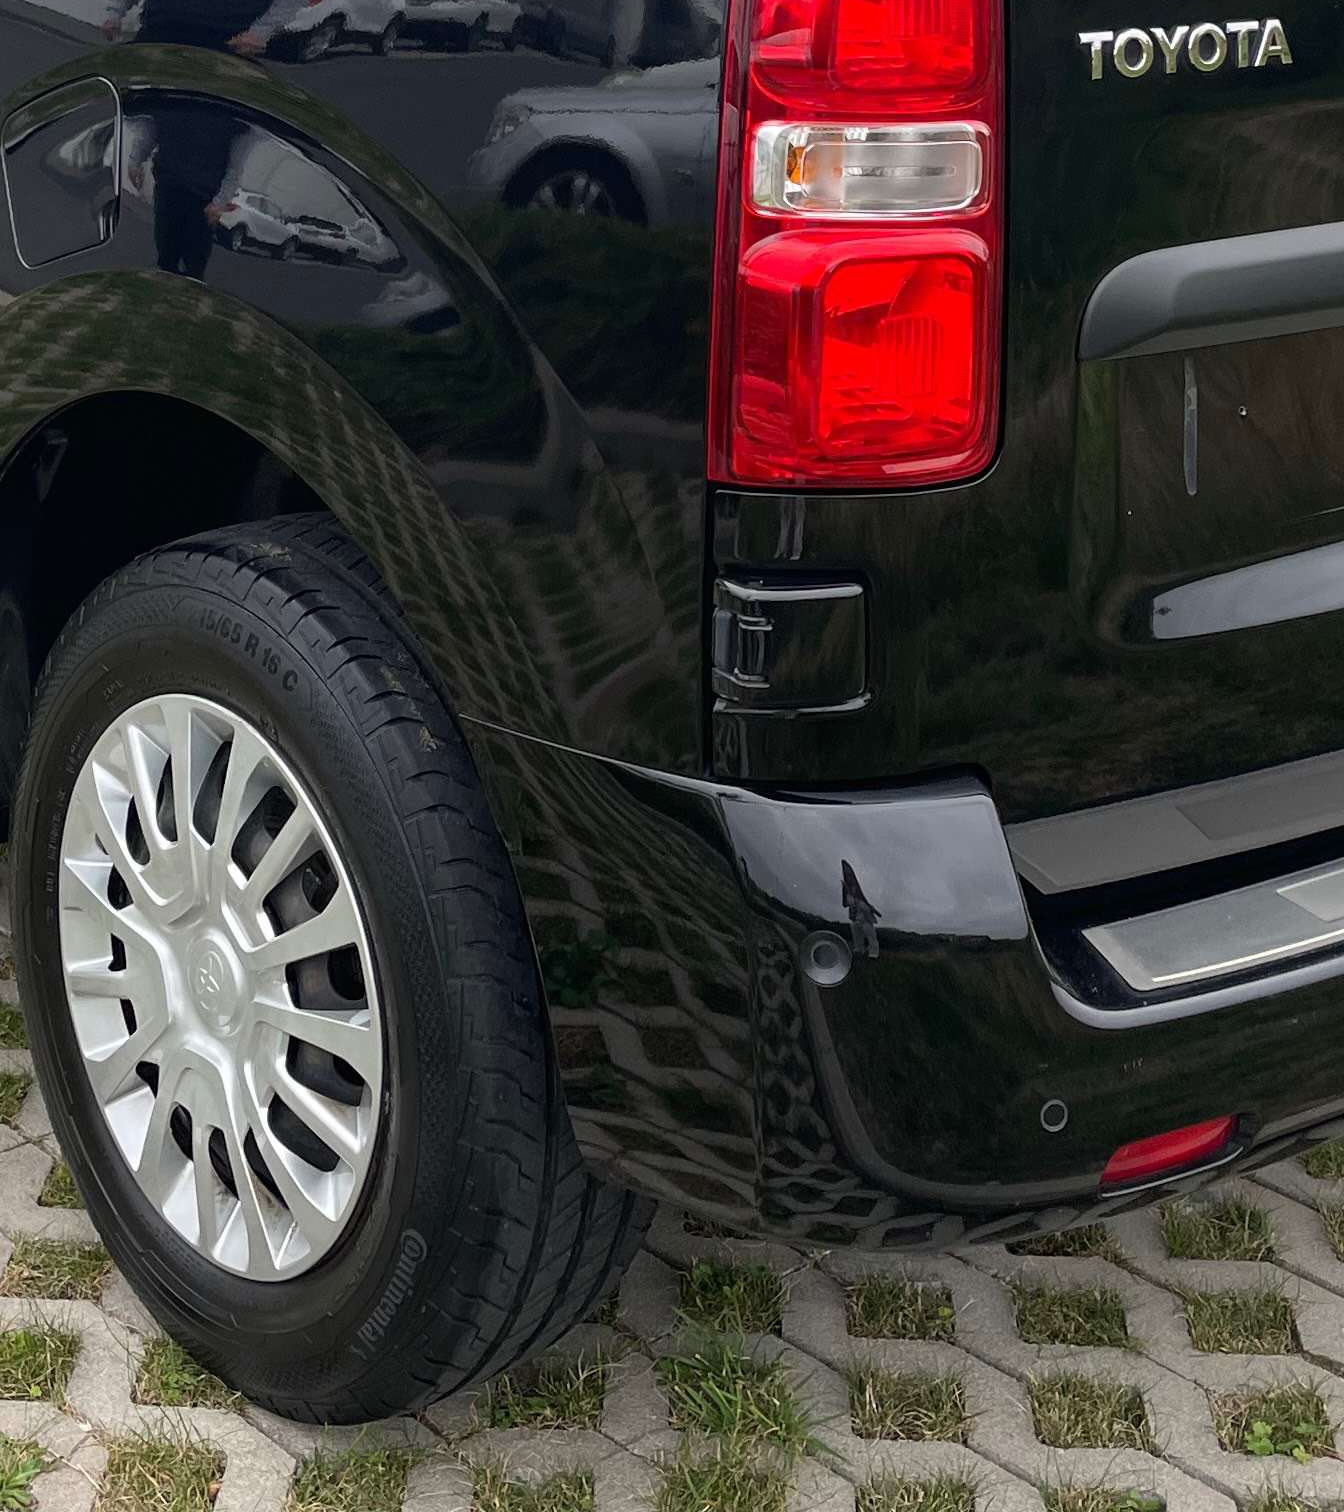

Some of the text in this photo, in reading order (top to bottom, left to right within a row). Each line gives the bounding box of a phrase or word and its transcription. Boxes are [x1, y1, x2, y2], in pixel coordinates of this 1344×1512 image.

[1078, 18, 1293, 80] TOYOTA
[244, 632, 260, 658] R
[261, 647, 282, 674] 16
[282, 669, 298, 691] C
[355, 1228, 428, 1353] Continental
